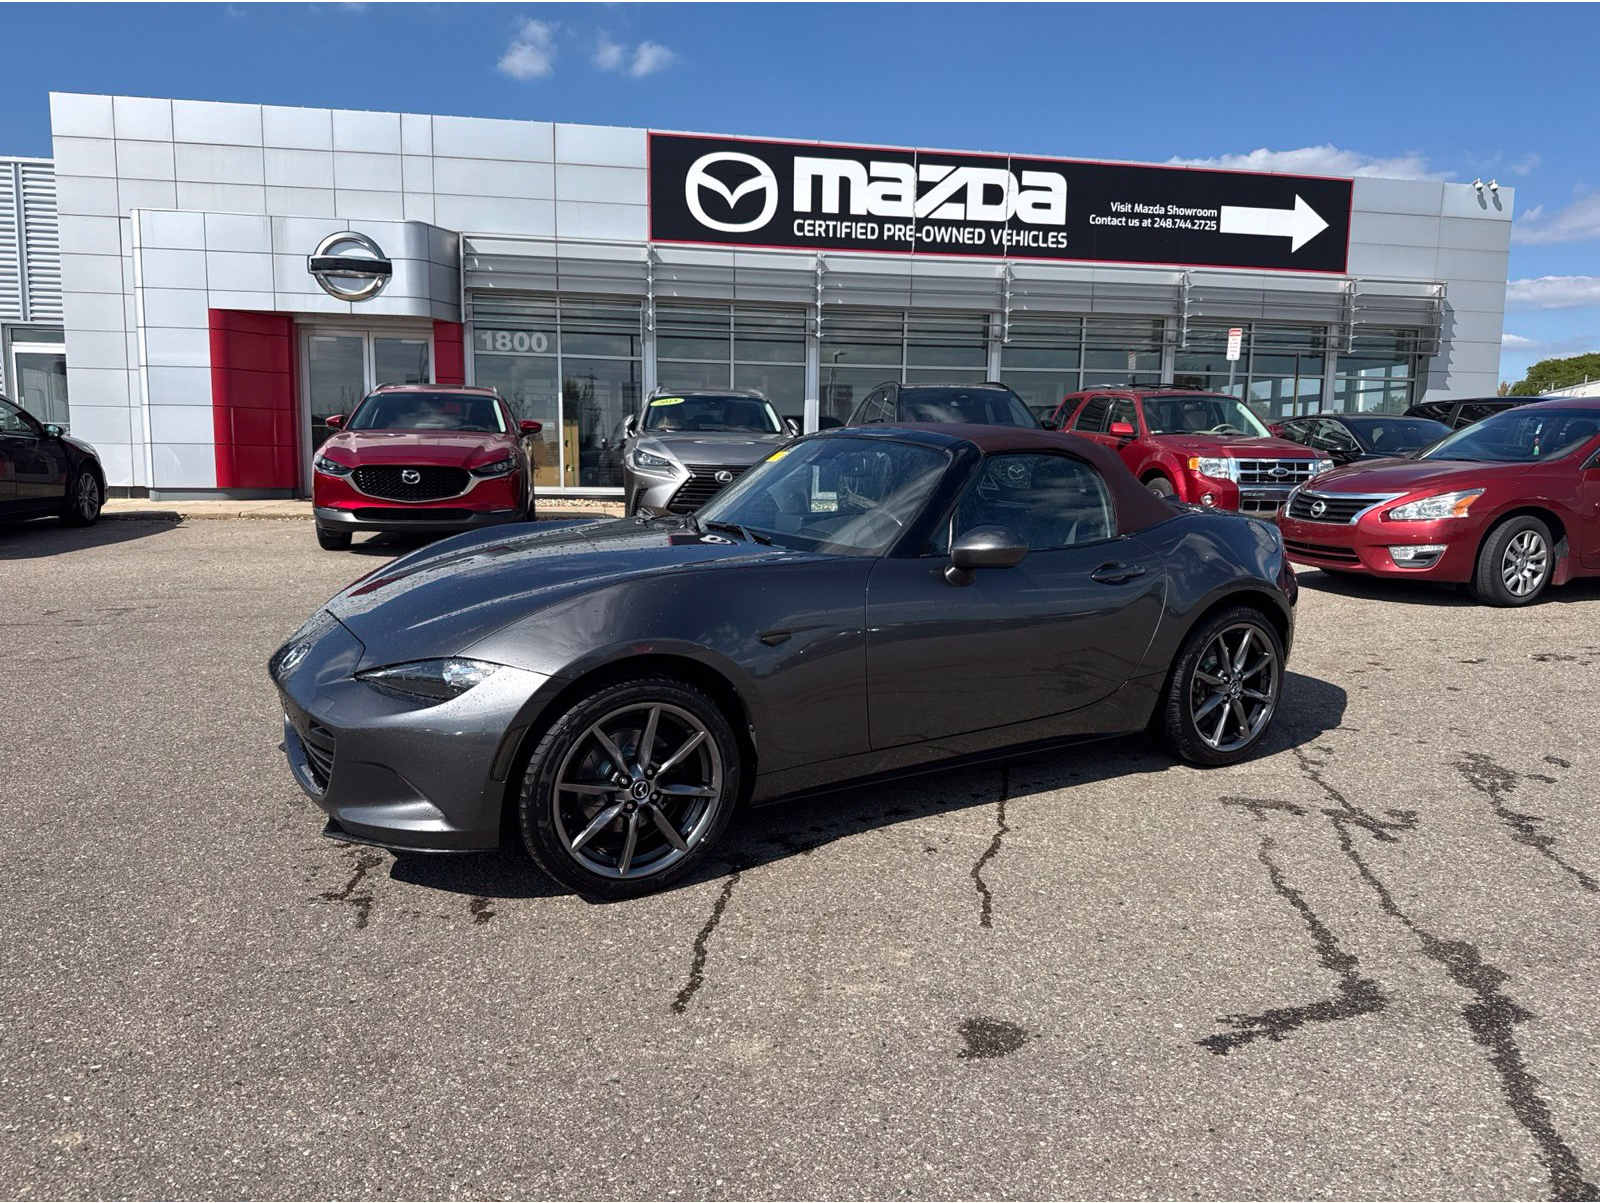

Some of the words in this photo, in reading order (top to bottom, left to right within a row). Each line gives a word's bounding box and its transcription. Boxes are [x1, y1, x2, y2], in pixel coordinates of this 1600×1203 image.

[1110, 201, 1132, 213] Visit
[1133, 203, 1165, 215] Mazda
[1167, 205, 1218, 217] Showroom
[1089, 214, 1126, 226] Contact
[1128, 219, 1140, 227] us
[1141, 218, 1152, 227] at
[1153, 217, 1217, 231] 248.744.2725
[793, 219, 879, 240] CERTIFIED
[883, 224, 986, 245] PRE-OWNED
[990, 229, 1068, 249] VEHICLES
[481, 331, 548, 352] 1800
